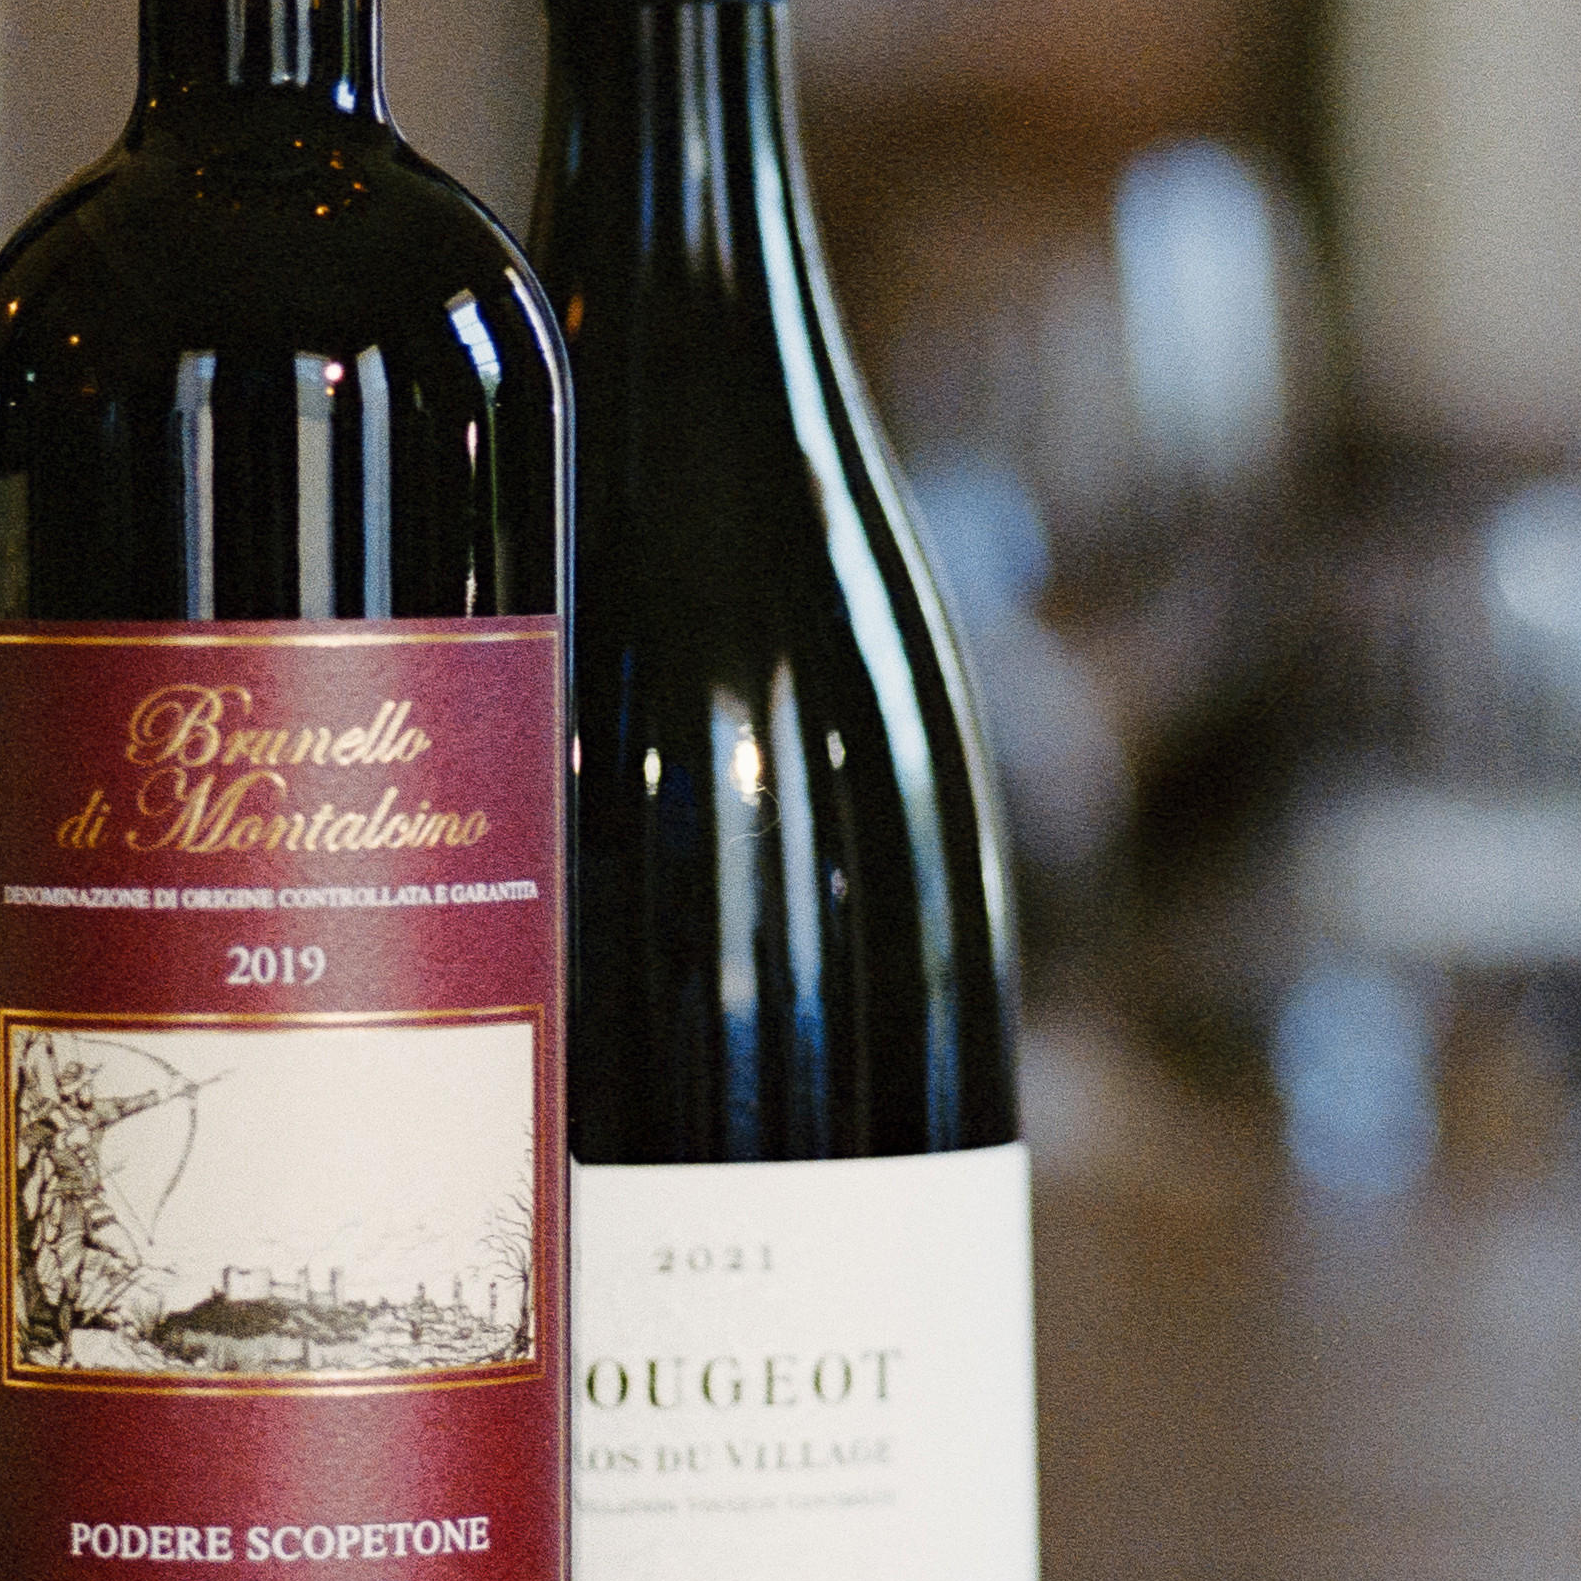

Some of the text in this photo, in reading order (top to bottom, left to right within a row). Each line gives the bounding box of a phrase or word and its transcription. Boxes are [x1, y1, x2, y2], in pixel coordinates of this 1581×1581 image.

[125, 683, 432, 768] Brunello
[57, 769, 491, 854] di Montalcino
[3, 881, 540, 910] DENOMINAZIONE DI ORIGINE CONTROLLATA E GARANTITA
[226, 945, 326, 986] 2019
[653, 1243, 775, 1274] 2021
[582, 1348, 903, 1411] OUGEOT
[69, 1516, 491, 1563] PODERE SCOPETONE
